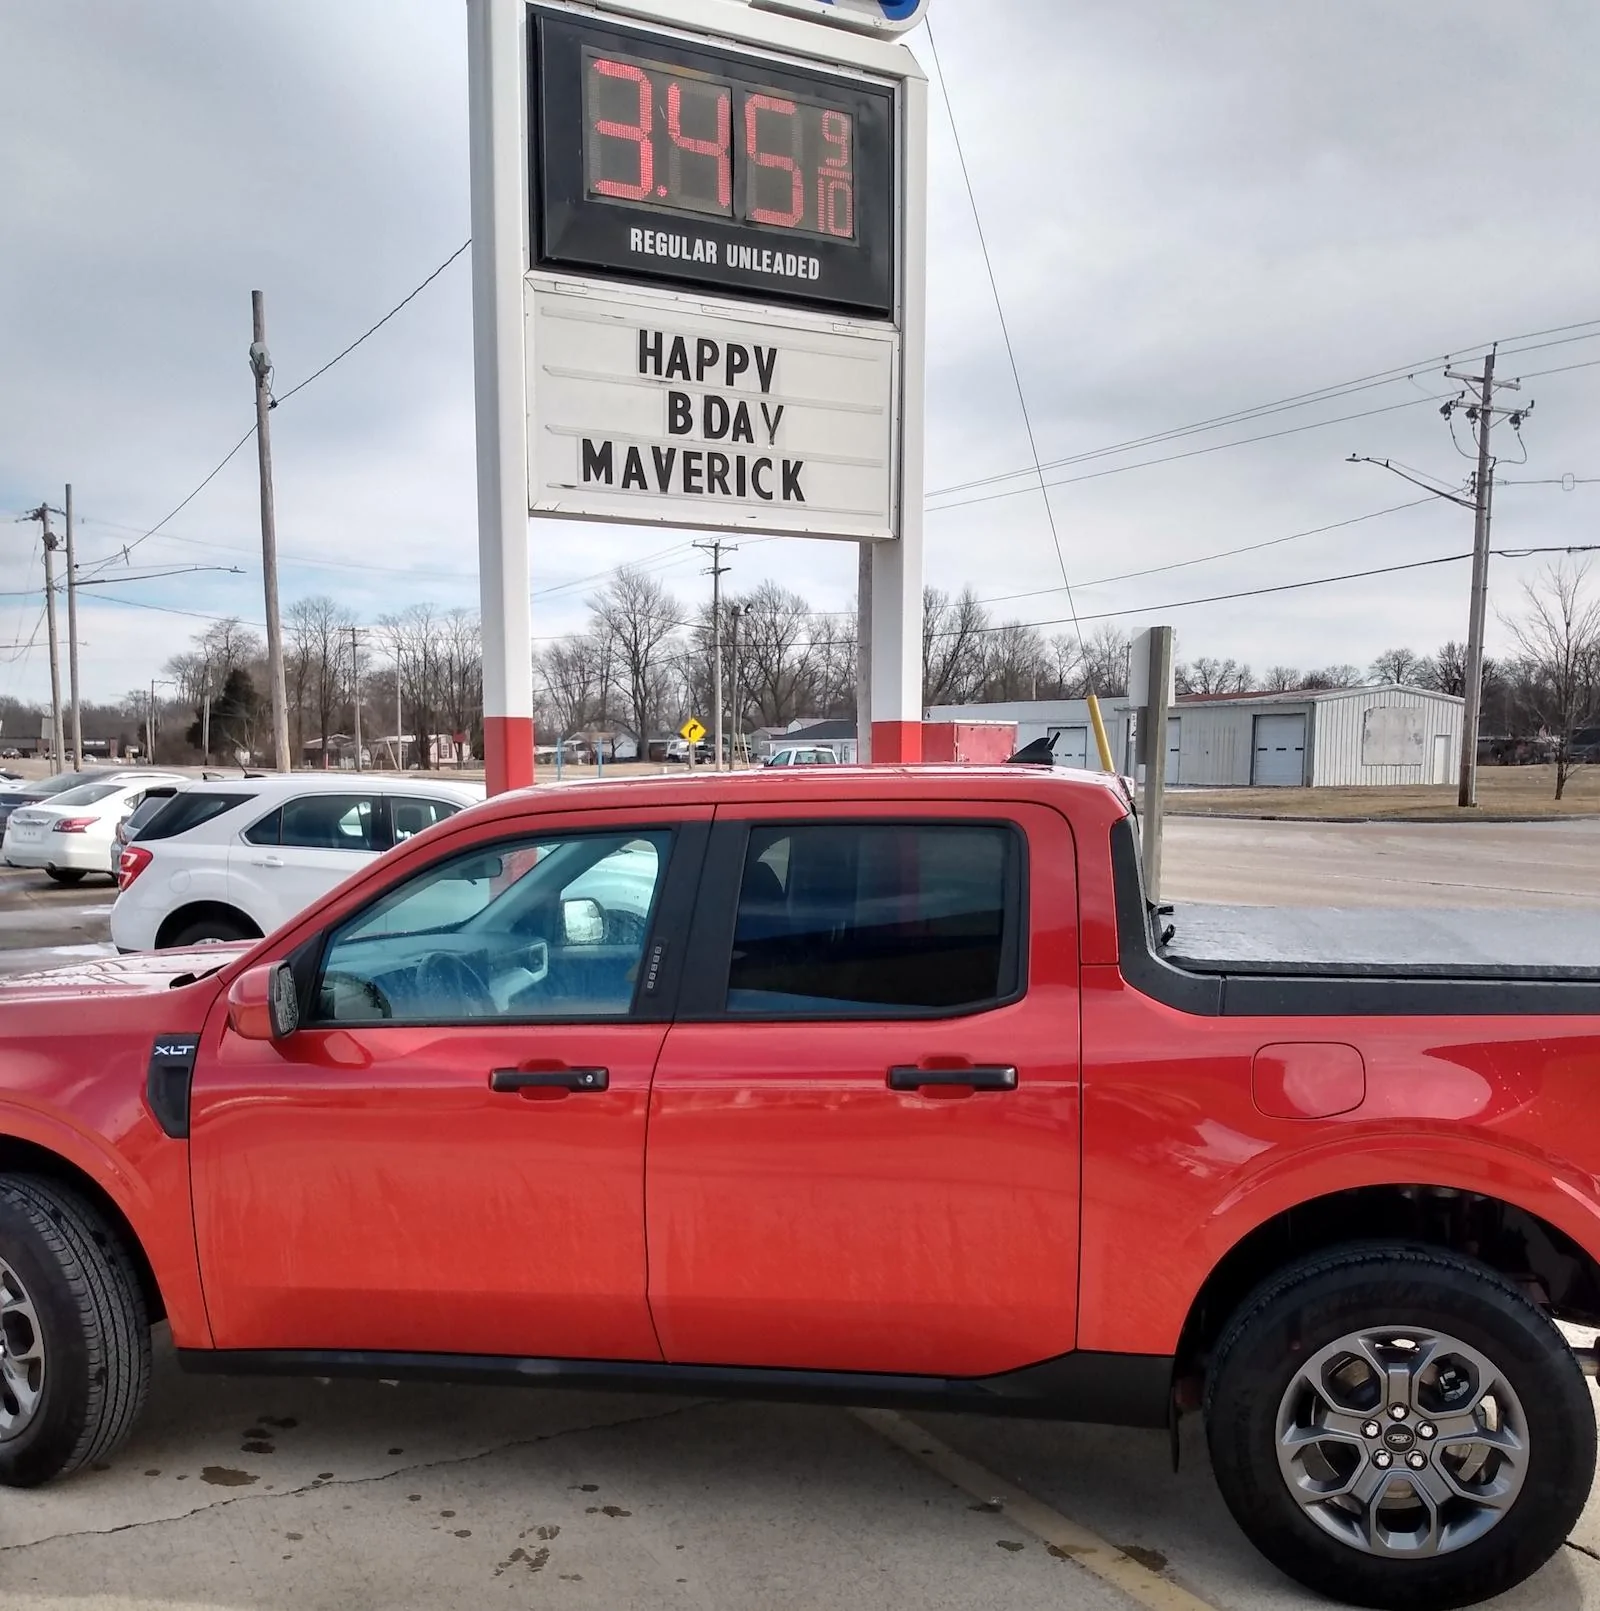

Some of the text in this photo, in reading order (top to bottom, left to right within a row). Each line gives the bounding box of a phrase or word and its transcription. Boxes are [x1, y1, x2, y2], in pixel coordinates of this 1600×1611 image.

[593, 58, 805, 228] 3.45
[630, 227, 820, 281] REGULAR UNLEADED
[582, 438, 806, 502] MAVERICK
[154, 1045, 195, 1056] XLT
